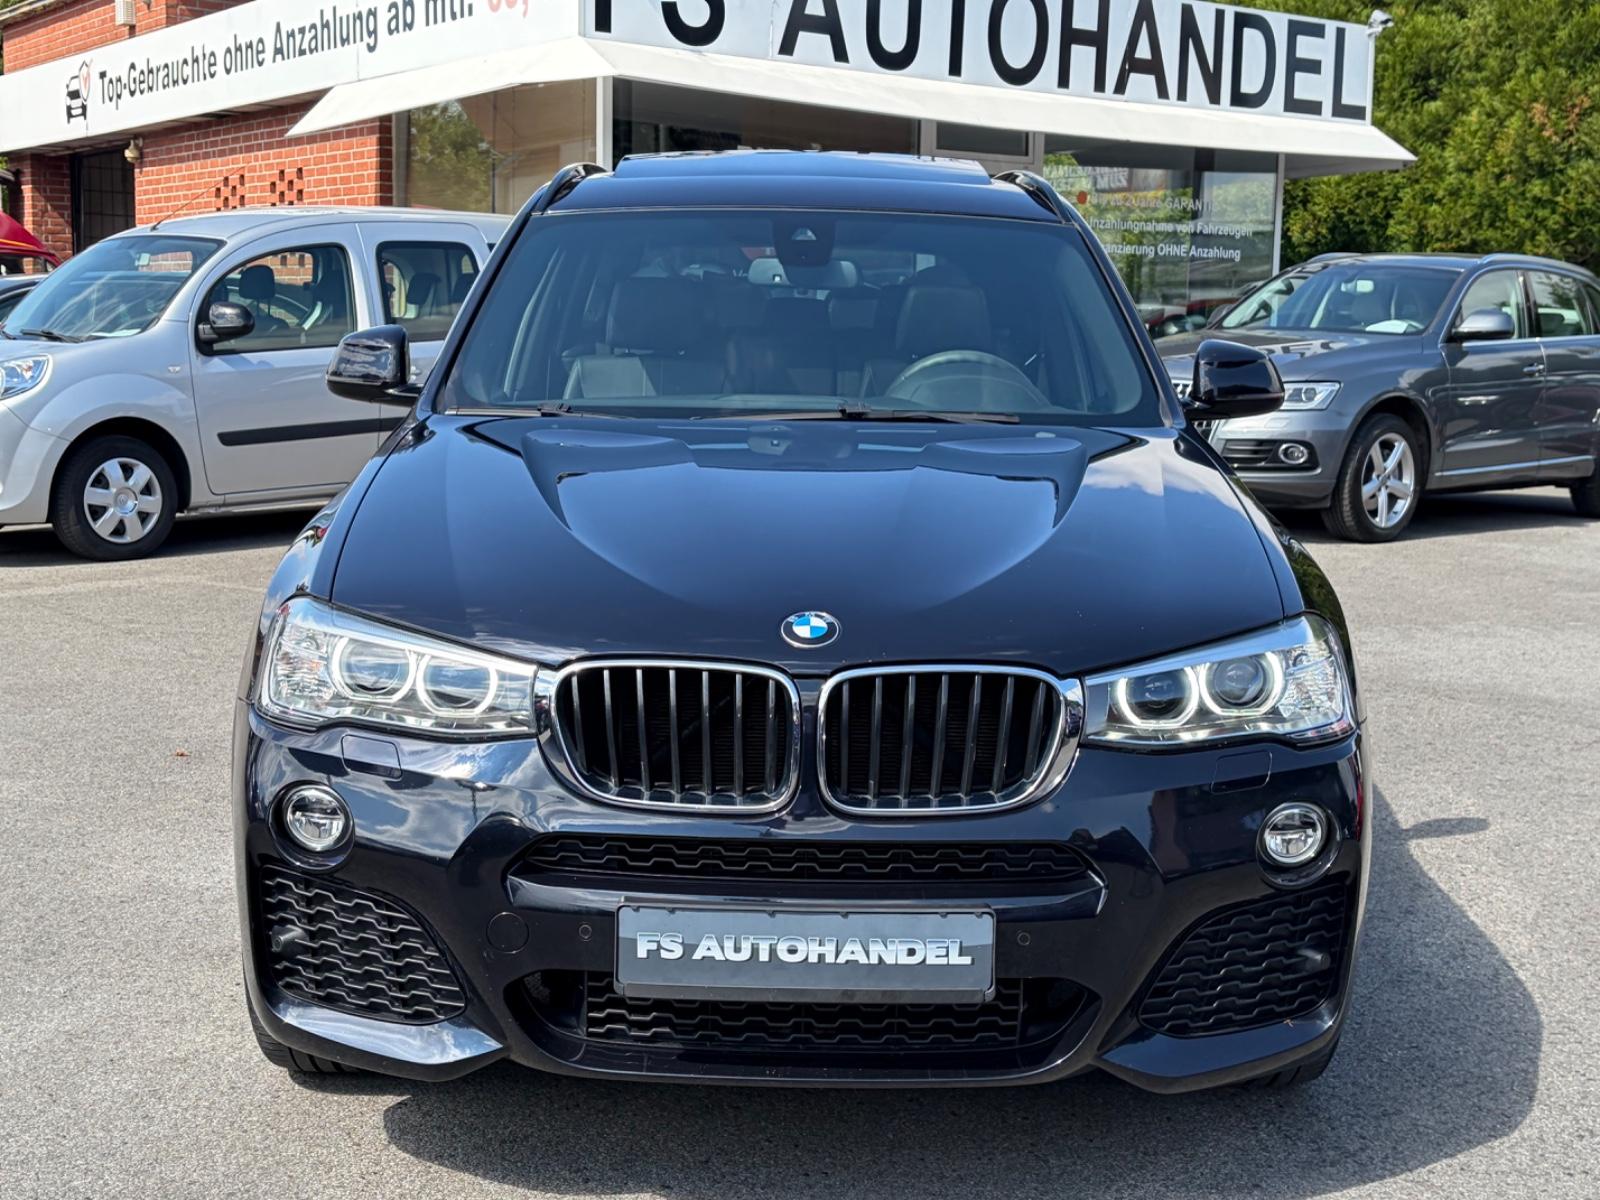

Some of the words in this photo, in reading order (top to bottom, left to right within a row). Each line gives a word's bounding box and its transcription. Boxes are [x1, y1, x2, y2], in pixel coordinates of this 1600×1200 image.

[98, 45, 218, 110] Top-Gebrauchte
[223, 32, 266, 75] ohne
[271, 5, 378, 64] Anzahlung
[387, 0, 416, 36] ab
[1089, 217, 1173, 233] Inzahlungnahme
[1174, 223, 1193, 233] von
[1196, 222, 1252, 238] Fahrzeugen
[1157, 243, 1188, 257] OHNE
[1189, 244, 1241, 262] Anzahlung
[636, 931, 684, 960] FS
[691, 933, 974, 966] AUTOHANDEL
